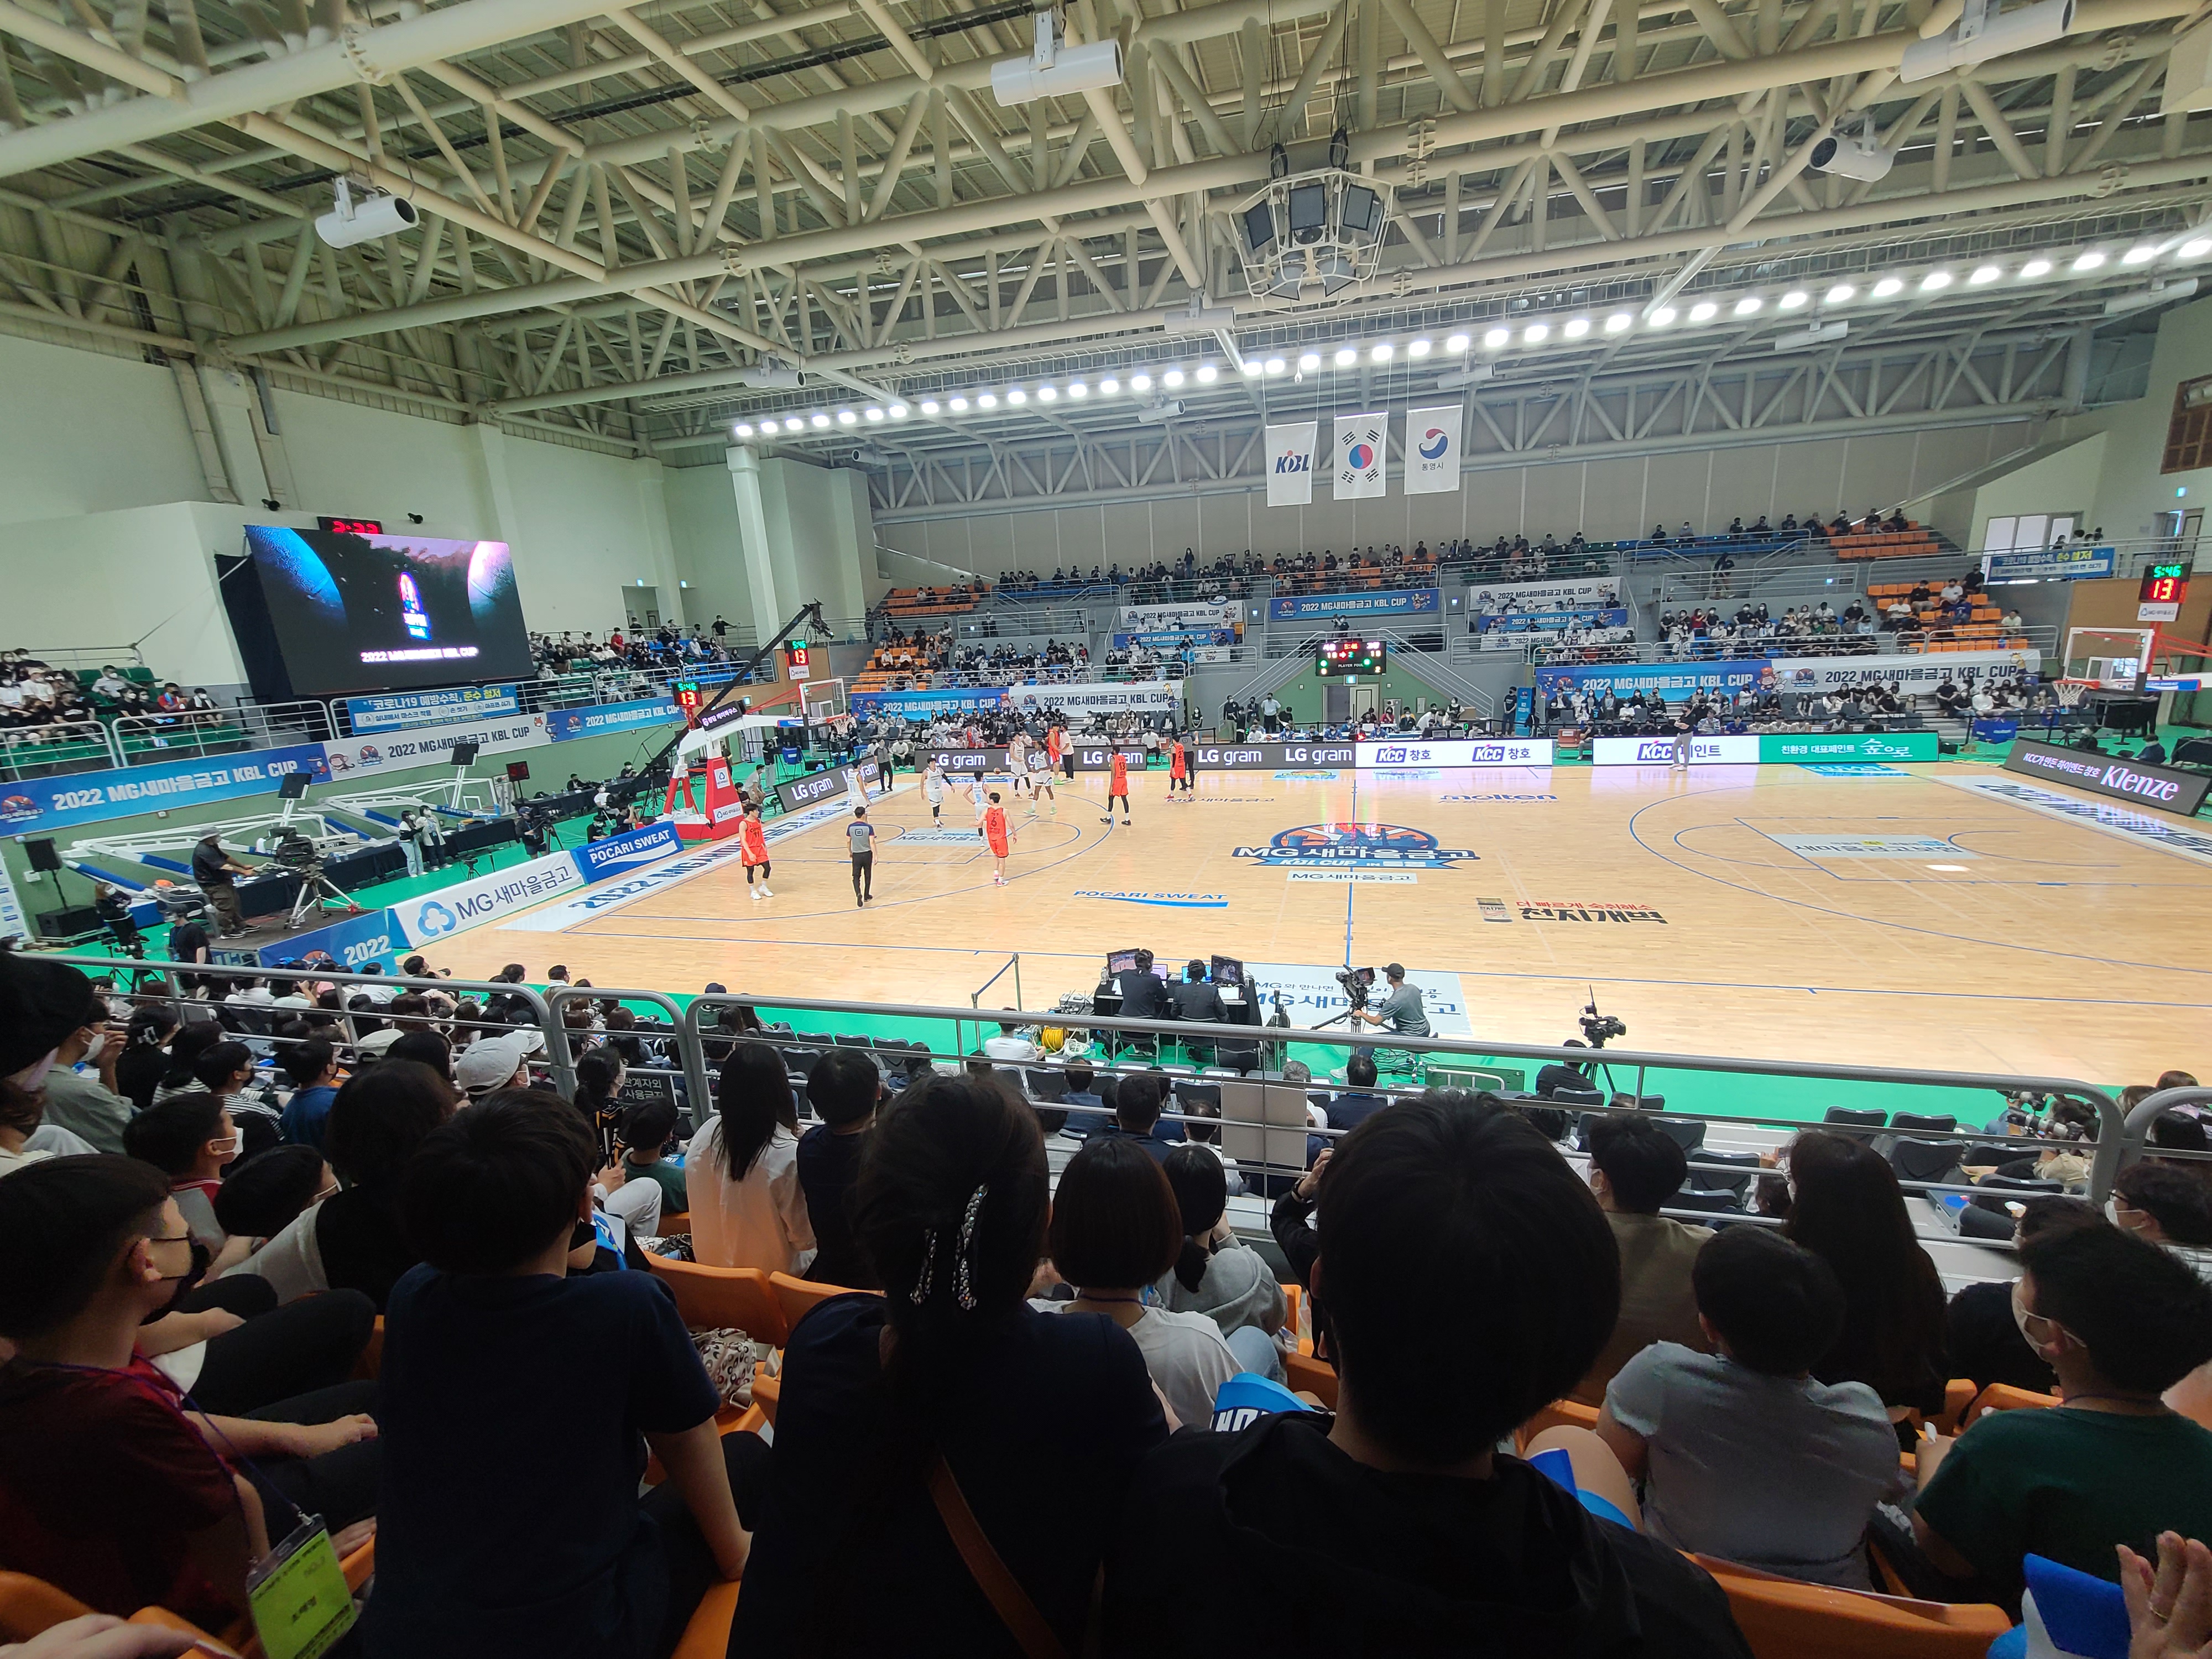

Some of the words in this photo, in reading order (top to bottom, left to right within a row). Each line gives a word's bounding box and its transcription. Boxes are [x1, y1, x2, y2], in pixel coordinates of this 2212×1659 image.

[1275, 453, 1309, 474] KBL
[1421, 462, 1444, 471] 통영시
[2154, 565, 2182, 578] 5:46
[1516, 588, 1561, 598] MG새마을금고
[2153, 578, 2174, 600] 13
[1301, 603, 1319, 612] 2022
[1321, 599, 1372, 611] MG새마을금고
[1374, 599, 1390, 608] KBL
[1391, 598, 1407, 607] CUP
[792, 640, 807, 649] 5:46
[794, 649, 806, 664] 13
[1825, 670, 1857, 684] 2022
[1860, 666, 1953, 683] MG새마을금고
[1958, 666, 1984, 679] KBL
[1989, 665, 2017, 678] CUP
[677, 682, 697, 691] 5:46
[1583, 679, 1610, 691] 2022
[1614, 675, 1696, 690] MG새마을금고
[1699, 675, 1724, 687] KBL
[1727, 674, 1753, 686] CUP
[463, 690, 482, 702] 준수
[483, 688, 502, 698] 철저
[681, 691, 697, 705] 13
[1044, 696, 1065, 707] 2022
[1067, 695, 1128, 706] MG새마을금고
[1130, 695, 1147, 705] KBL
[1150, 693, 1168, 703] CUP
[883, 702, 904, 712] 2022
[905, 700, 959, 712] MG새마을금고
[961, 700, 978, 709] KBL
[979, 698, 996, 708] CUP
[375, 712, 400, 722] 실내에서
[401, 711, 419, 719] 마스크
[586, 716, 604, 728] 2022
[606, 707, 652, 724] MG새마을금고
[653, 707, 666, 717] KBL
[667, 705, 680, 715] CUP
[388, 744, 416, 758] 2022
[491, 729, 510, 742] KBL
[512, 726, 530, 738] CUP
[1781, 744, 1808, 755] 친환경
[1810, 744, 1856, 754] 대표페인트
[1859, 738, 1913, 759] 숲으로
[1083, 750, 1103, 765] LG
[1197, 749, 1219, 763] LG
[1222, 749, 1262, 766] gram
[1285, 747, 1307, 762] LG
[1311, 747, 1353, 765] gram
[1379, 748, 1405, 763] KCC
[1409, 749, 1432, 760] 창호
[1475, 746, 1503, 761] KCC
[1508, 748, 1531, 760] 창호
[1639, 743, 1673, 759] KCC
[931, 753, 950, 767] LG
[953, 754, 986, 773] gram
[1119, 761, 1126, 771] 13
[2023, 752, 2046, 765] KCC가
[2043, 756, 2059, 769] 만든
[2083, 765, 2101, 778] 창호
[2100, 764, 2180, 801] Klenze
[52, 787, 106, 811] 2022
[107, 770, 231, 802] MG새마을금고
[232, 764, 266, 783] KBL
[267, 760, 298, 778] CUP
[791, 784, 809, 801] LG
[809, 777, 834, 799] gram
[975, 794, 982, 803] 5
[991, 817, 998, 827] 6
[589, 840, 634, 864] POCARI
[633, 830, 671, 850] SWEAT
[1237, 847, 1475, 860] MG새마을금고
[1280, 858, 1317, 866] KBL
[1292, 872, 1412, 881] MG새마을금고
[455, 865, 572, 920] MG새마을금고
[568, 879, 663, 909] 2022
[1588, 902, 1656, 911] 숙취해소
[1518, 907, 1670, 924] 천지개벽
[343, 935, 392, 966] 2022
[1300, 983, 1334, 992] 만나면
